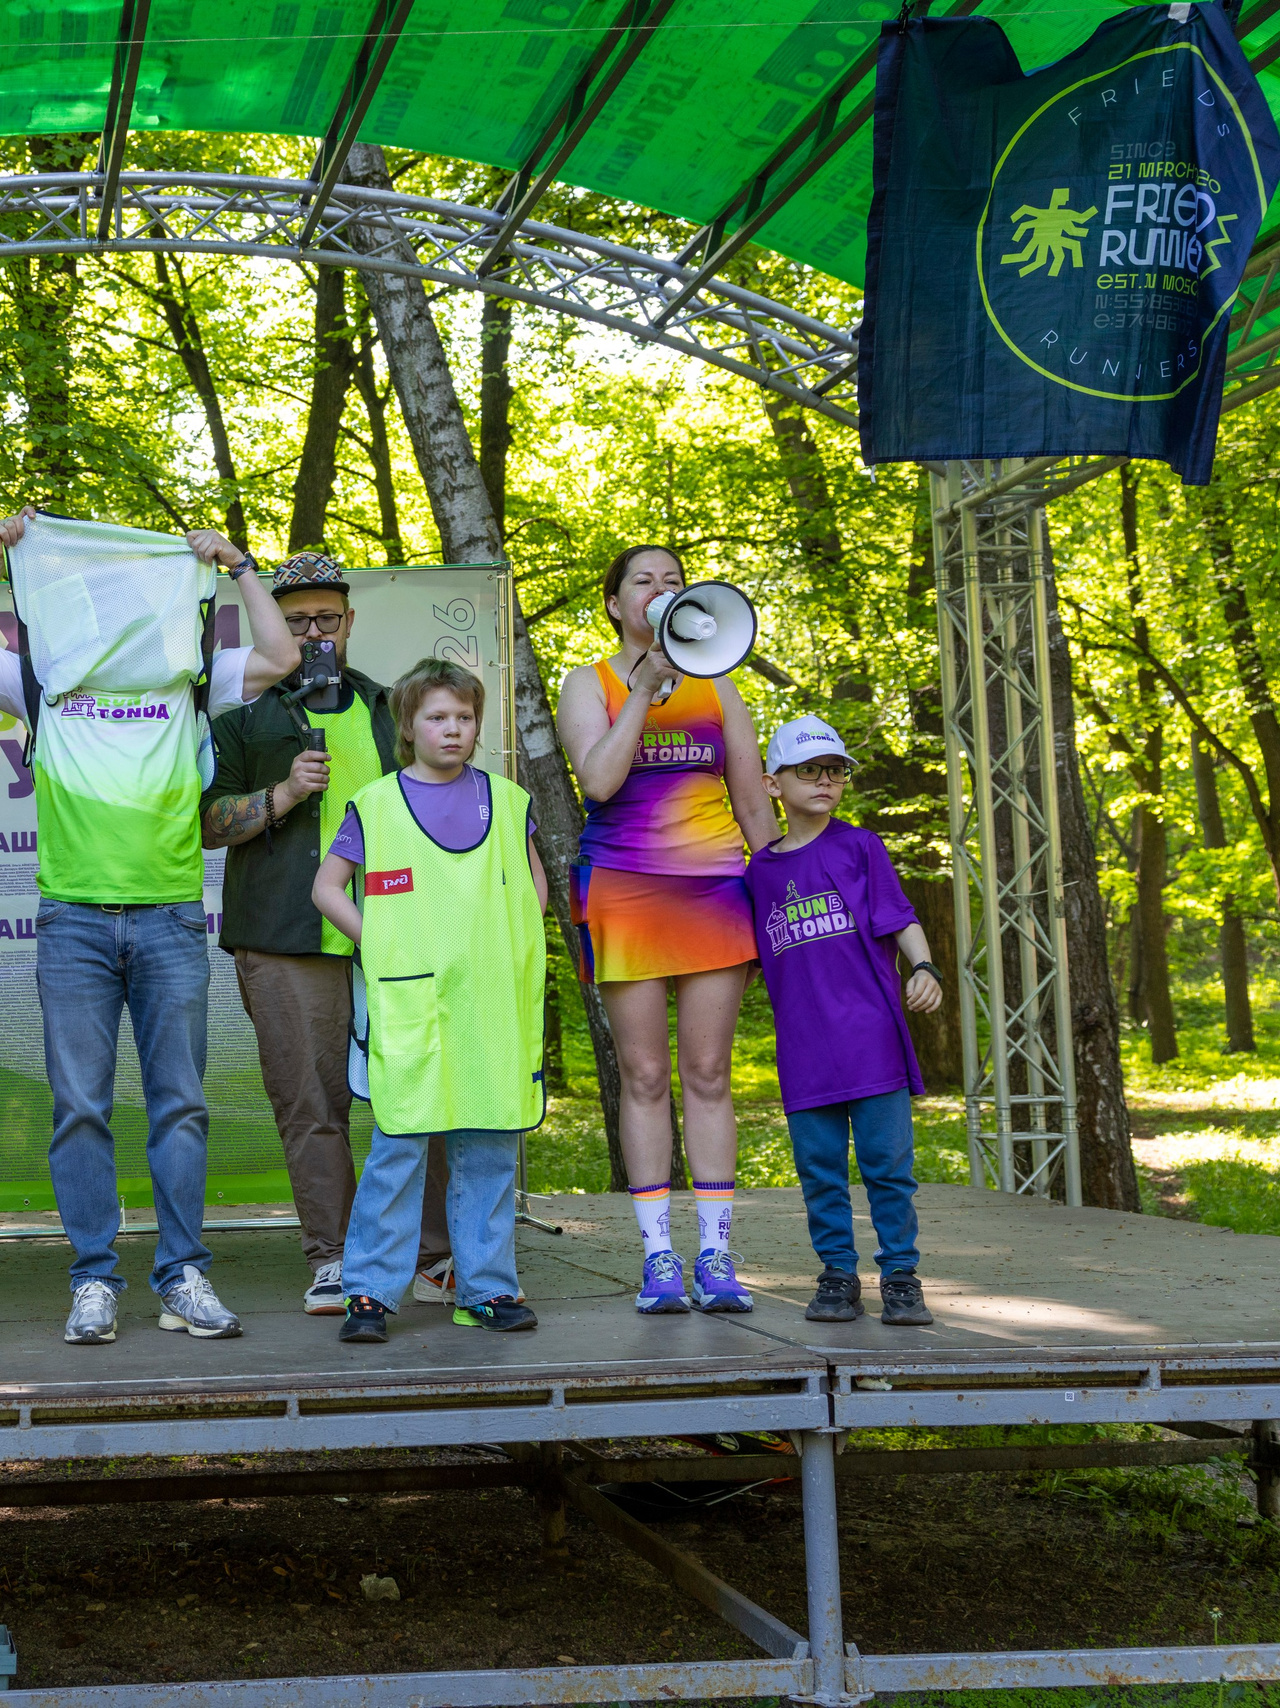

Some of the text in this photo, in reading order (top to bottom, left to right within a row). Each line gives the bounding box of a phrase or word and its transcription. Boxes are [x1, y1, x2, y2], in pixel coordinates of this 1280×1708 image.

[1108, 163, 1132, 180] 21
[1162, 274, 1200, 296] MOSC
[96, 696, 141, 707] RUN
[96, 703, 170, 720] TONDA
[643, 732, 687, 747] RUN
[644, 746, 713, 762] TONDA
[786, 896, 829, 923] RUN
